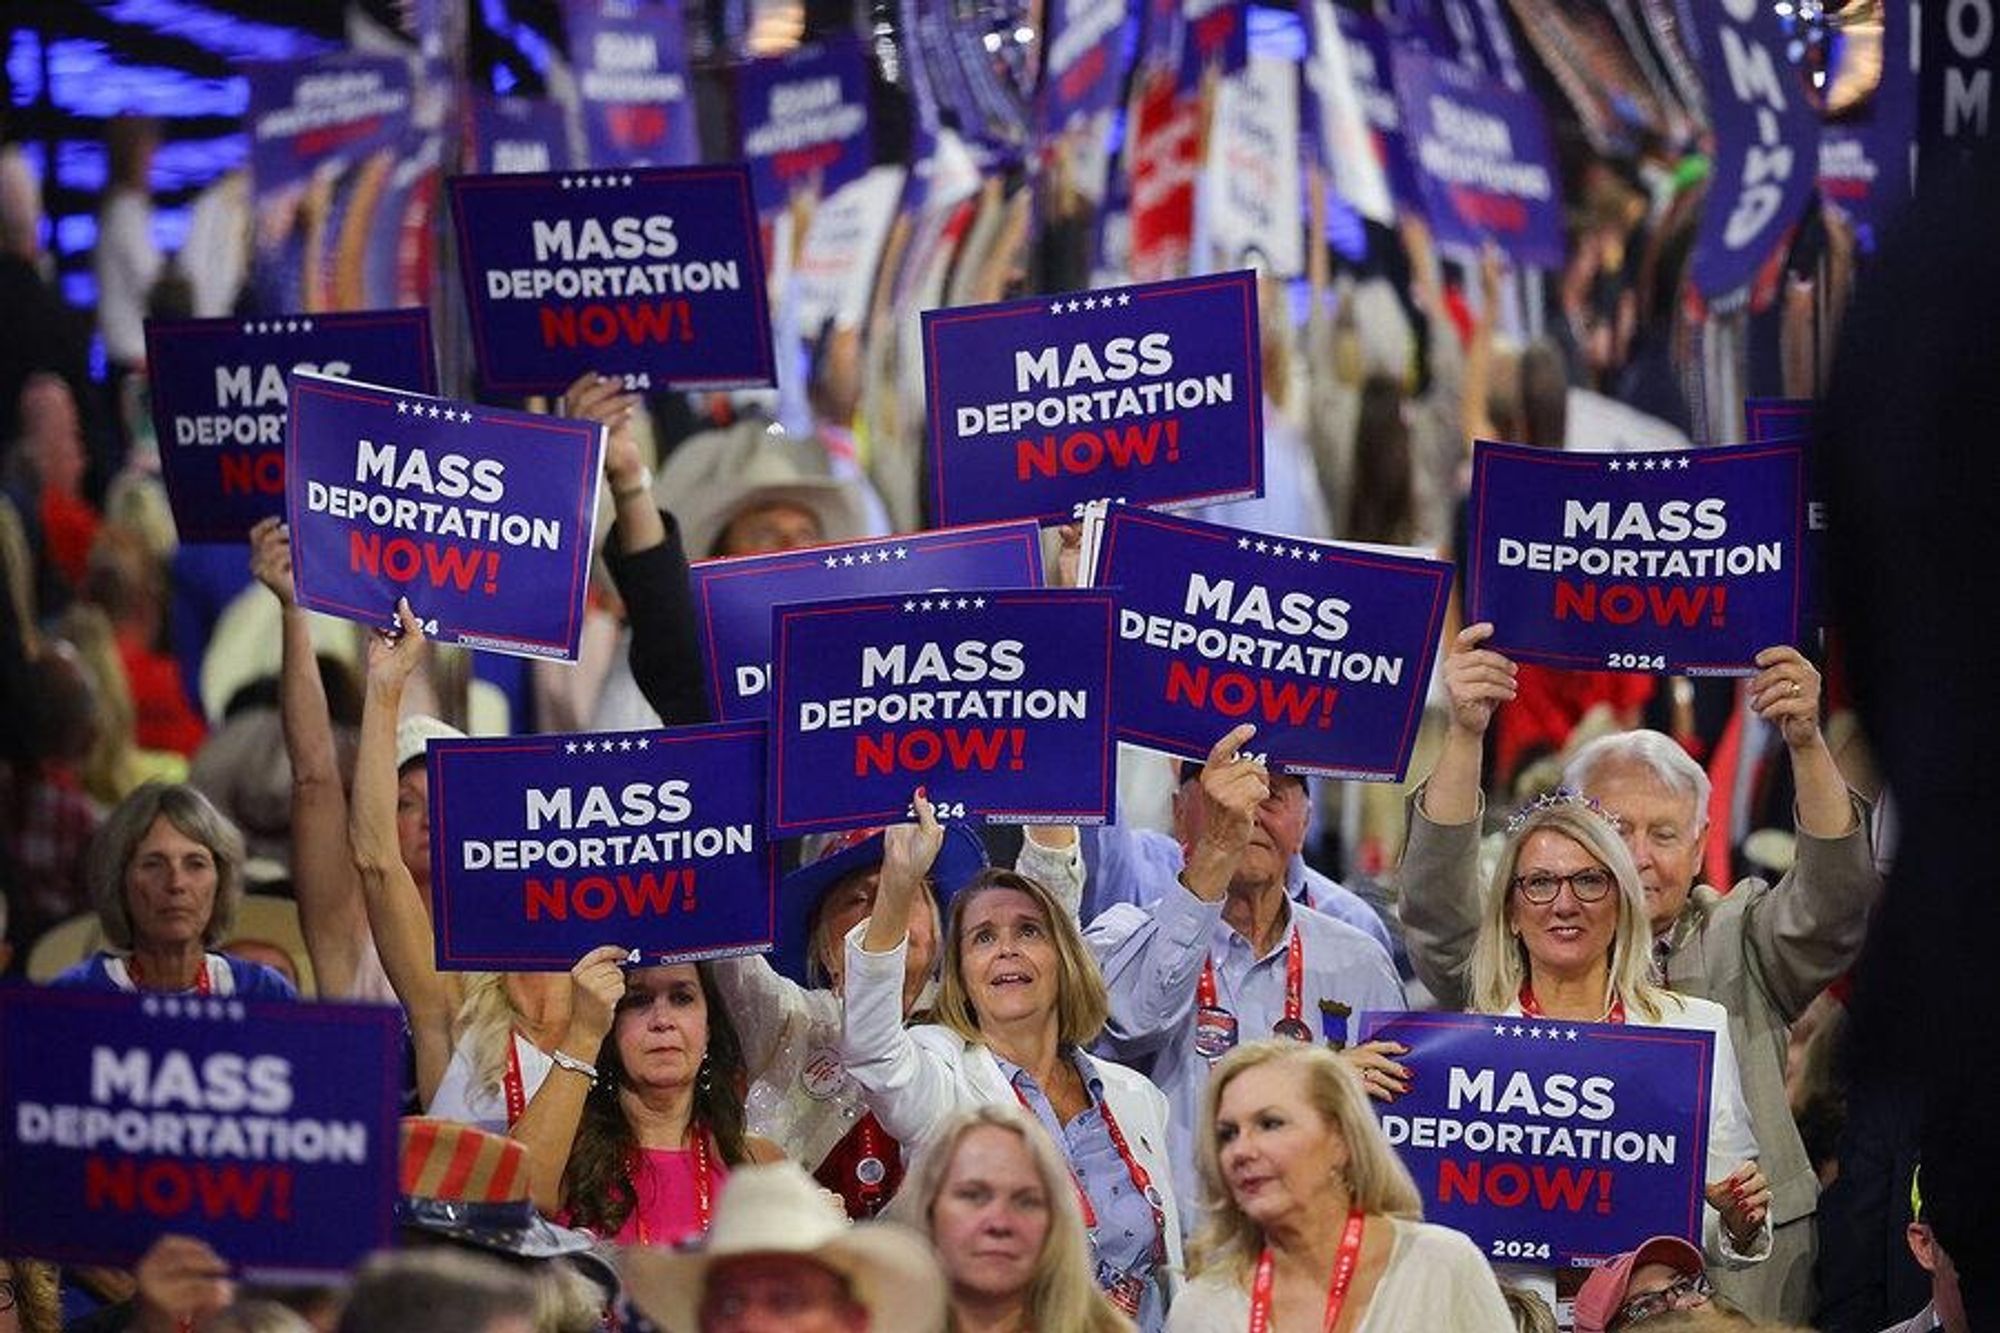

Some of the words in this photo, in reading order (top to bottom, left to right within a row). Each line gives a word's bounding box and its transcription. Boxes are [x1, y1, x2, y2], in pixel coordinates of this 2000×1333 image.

[534, 217, 677, 260] MASS
[489, 261, 740, 297] DEPORTATION
[541, 302, 691, 346] NOW!
[1016, 334, 1172, 392] MASS
[176, 414, 285, 444] DEPOR
[958, 374, 1232, 436] DEPORTATION
[357, 440, 504, 501] MASS
[1017, 420, 1178, 479] NOW!
[309, 481, 559, 550] DEPORTATION
[1564, 499, 1726, 541] MASS
[351, 532, 499, 593] NOW!
[1499, 539, 1781, 576] DEPORTATION
[1184, 574, 1350, 640] MASS
[1555, 581, 1726, 625] NOW!
[863, 640, 1024, 687] MASS
[1121, 609, 1402, 684] DEPORTATION
[1608, 654, 1665, 669] 2024
[801, 690, 1086, 730] DEPORTATION
[1167, 662, 1337, 727] NOW!
[855, 728, 1025, 775] NOW!
[527, 781, 691, 830] MASS
[464, 825, 752, 869] DEPORTATION
[526, 870, 695, 919] NOW!
[94, 1050, 291, 1111] MASS
[1449, 1067, 1614, 1120] MASS
[18, 1105, 366, 1163] DEPORTATION
[1383, 1116, 1674, 1163] DEPORTATION
[85, 1160, 294, 1223] NOW!
[1439, 1160, 1611, 1211] NOW!
[1493, 1241, 1550, 1258] 2024
